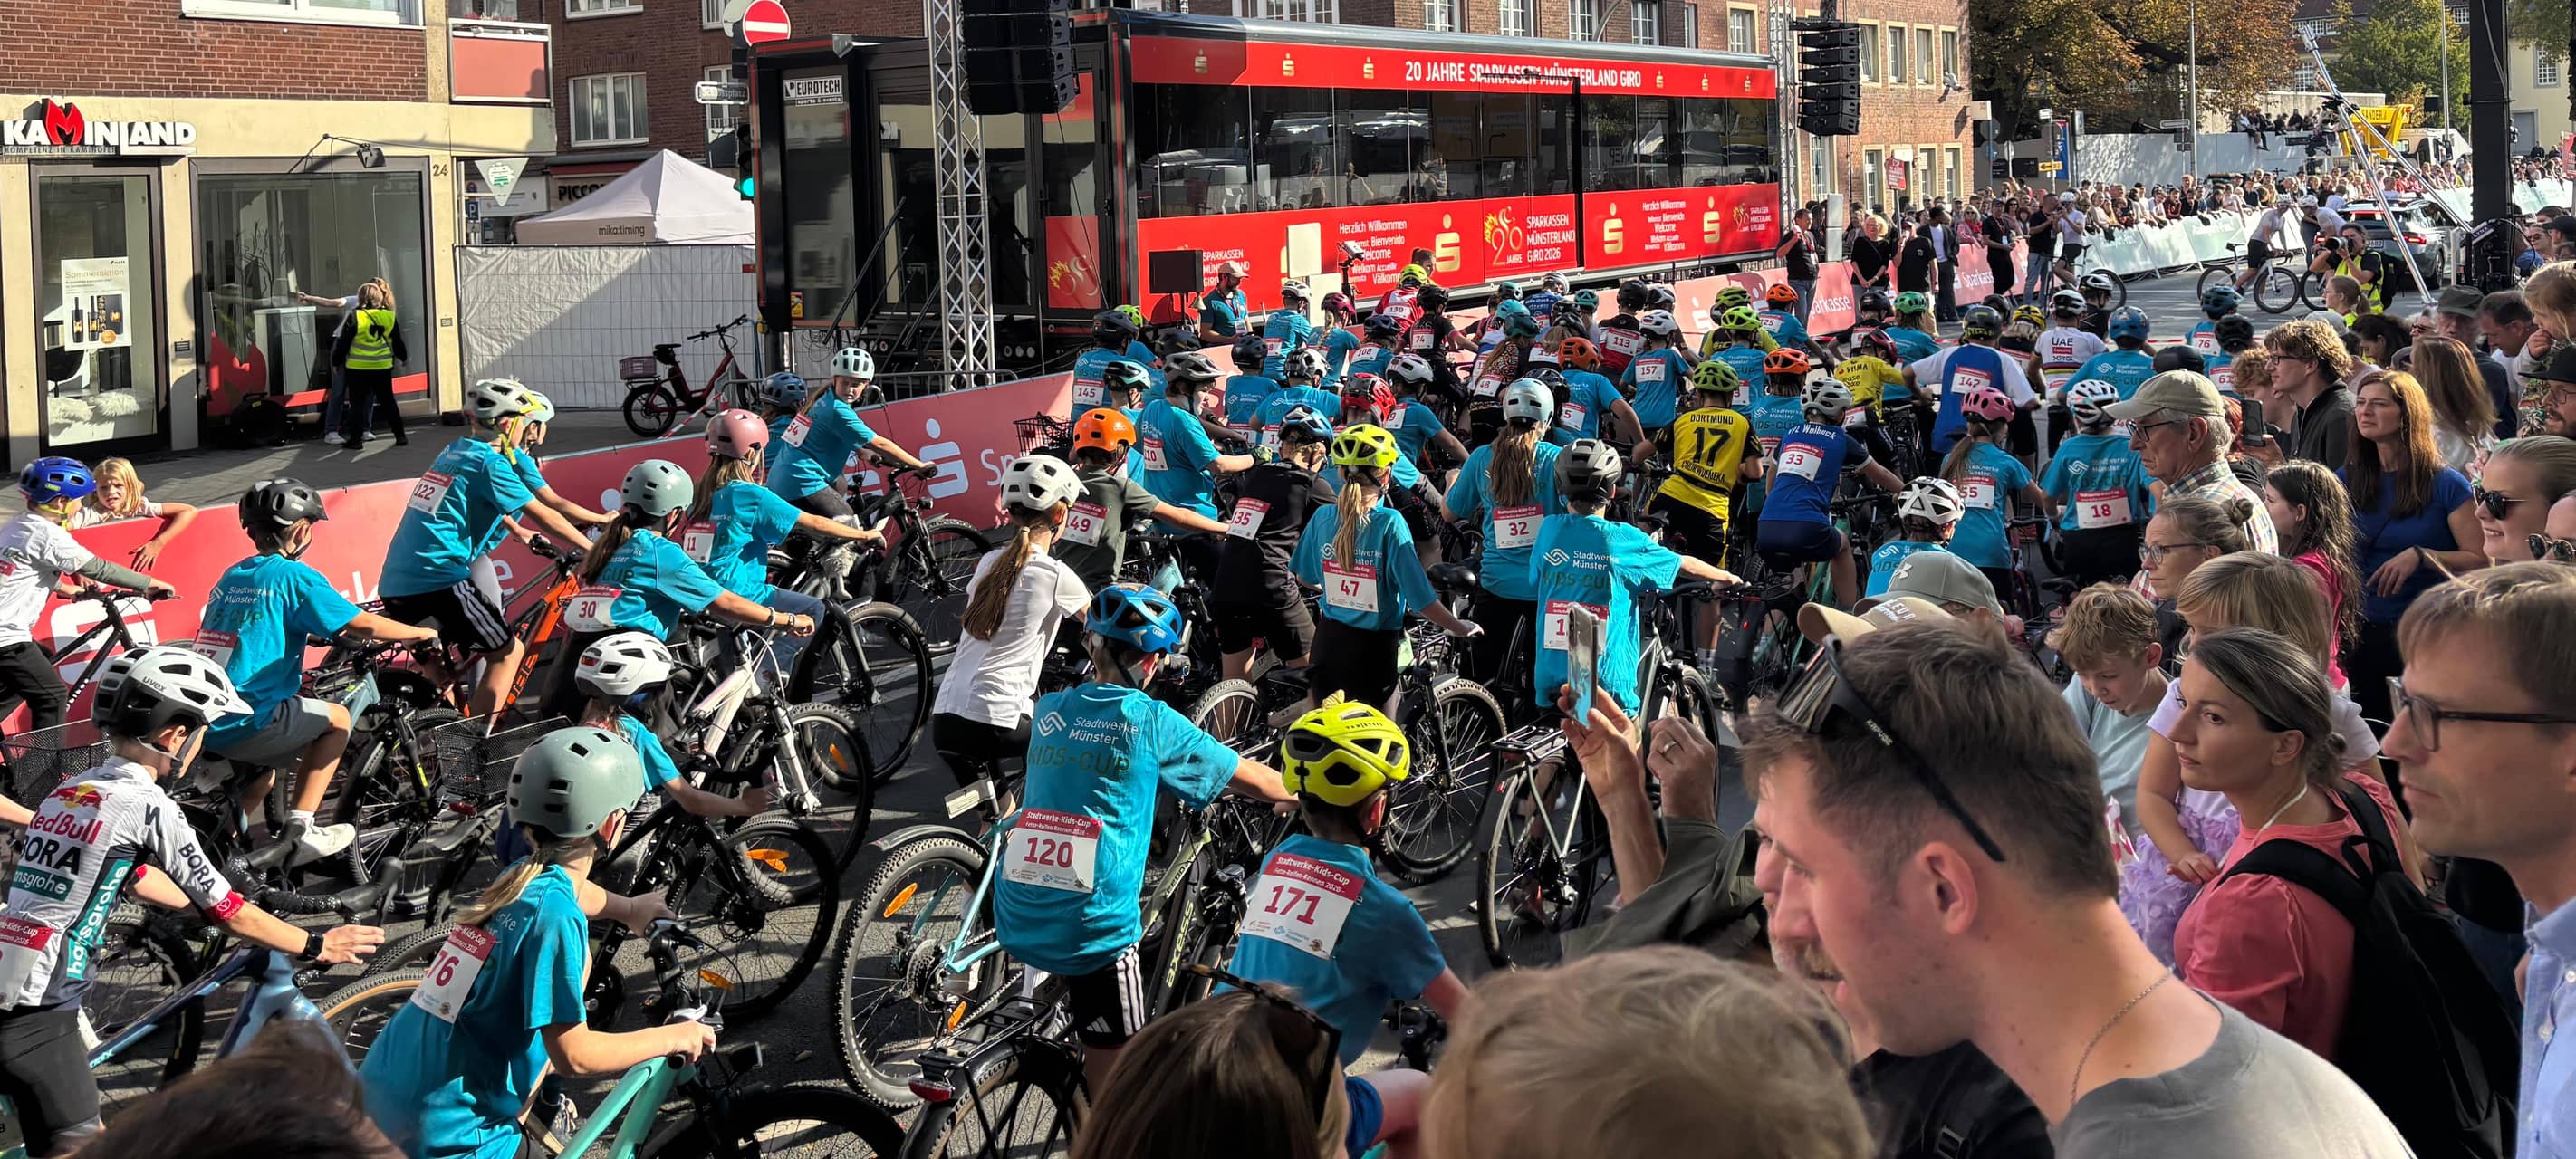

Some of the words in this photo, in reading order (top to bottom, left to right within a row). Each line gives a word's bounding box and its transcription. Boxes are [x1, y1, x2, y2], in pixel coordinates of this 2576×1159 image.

[1405, 61, 1421, 81] 20
[1426, 62, 1465, 83] JAHRE
[1469, 63, 1540, 85] SPARKASSEN
[1543, 62, 1618, 88] MÜNSTERLAND
[1620, 69, 1640, 88] GIRO
[796, 79, 841, 96] EUROTECH
[3, 98, 197, 155] KAMINLAND
[5, 146, 53, 154] KOMPETENZ
[56, 146, 66, 154] IN
[433, 164, 448, 177] 24
[558, 183, 605, 201] PICCO
[469, 203, 476, 215] P
[1340, 221, 1366, 234] Herzlich
[1368, 219, 1407, 232] Willkommen
[1527, 214, 1569, 229] SPARKASSEN
[598, 224, 646, 237] mika:timing
[1527, 228, 1576, 246] MÜNSTERLAND
[1370, 235, 1406, 247] Bienvenido
[1203, 249, 1244, 262] SPARKASSEN
[1506, 254, 1523, 264] JAHRE
[1527, 248, 1544, 262] GIRO
[1545, 247, 1562, 261] 2026
[1963, 270, 1994, 290] Sparkass
[1811, 295, 1852, 319] parkasse
[1613, 336, 1630, 349] 113
[2052, 338, 2073, 347] UAE
[2198, 339, 2210, 349] 76
[1358, 348, 1371, 357] 108
[1640, 366, 1658, 376] 157
[1078, 388, 1096, 398] 145
[1690, 414, 1734, 425] DORTMUND
[1693, 427, 1731, 467] 17
[1786, 453, 1803, 466] 33
[414, 484, 436, 500] 122
[2091, 503, 2112, 518] 18
[1509, 521, 1530, 536] 32
[1573, 550, 1619, 563] Stadtwerke
[1572, 560, 1607, 571] Münster
[1341, 579, 1360, 597] 47
[224, 595, 258, 604] Münster
[579, 600, 597, 618] 30
[142, 675, 167, 693] uvex
[1073, 716, 1139, 736] Stadtwerke
[1068, 729, 1119, 745] Münster
[1026, 811, 1091, 828] Stadtwerke-Kids-Cup
[57, 814, 103, 845] Bull
[22, 835, 82, 876] BORA
[1024, 836, 1074, 868] 120
[178, 842, 216, 894] BORA
[1275, 857, 1350, 886] Stadtwerke-Kids-Cup
[14, 868, 68, 895] ansgrohe
[1264, 884, 1322, 925] 171
[1166, 900, 1195, 989] axess
